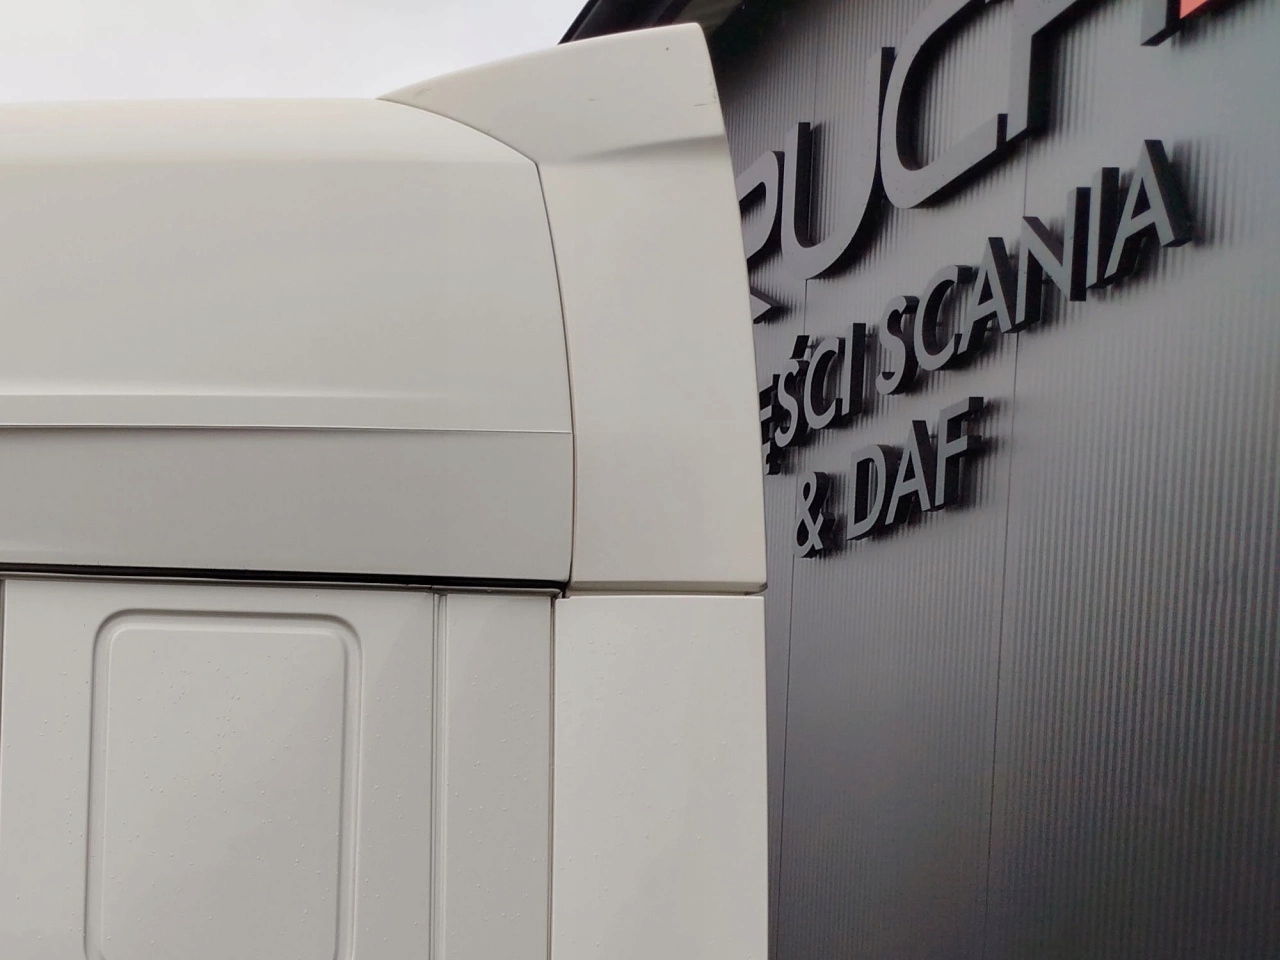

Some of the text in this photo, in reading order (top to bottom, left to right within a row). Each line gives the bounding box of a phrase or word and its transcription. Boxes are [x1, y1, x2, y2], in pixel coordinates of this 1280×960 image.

[876, 139, 1192, 396] SCANIA
[792, 397, 983, 558] & DAF
